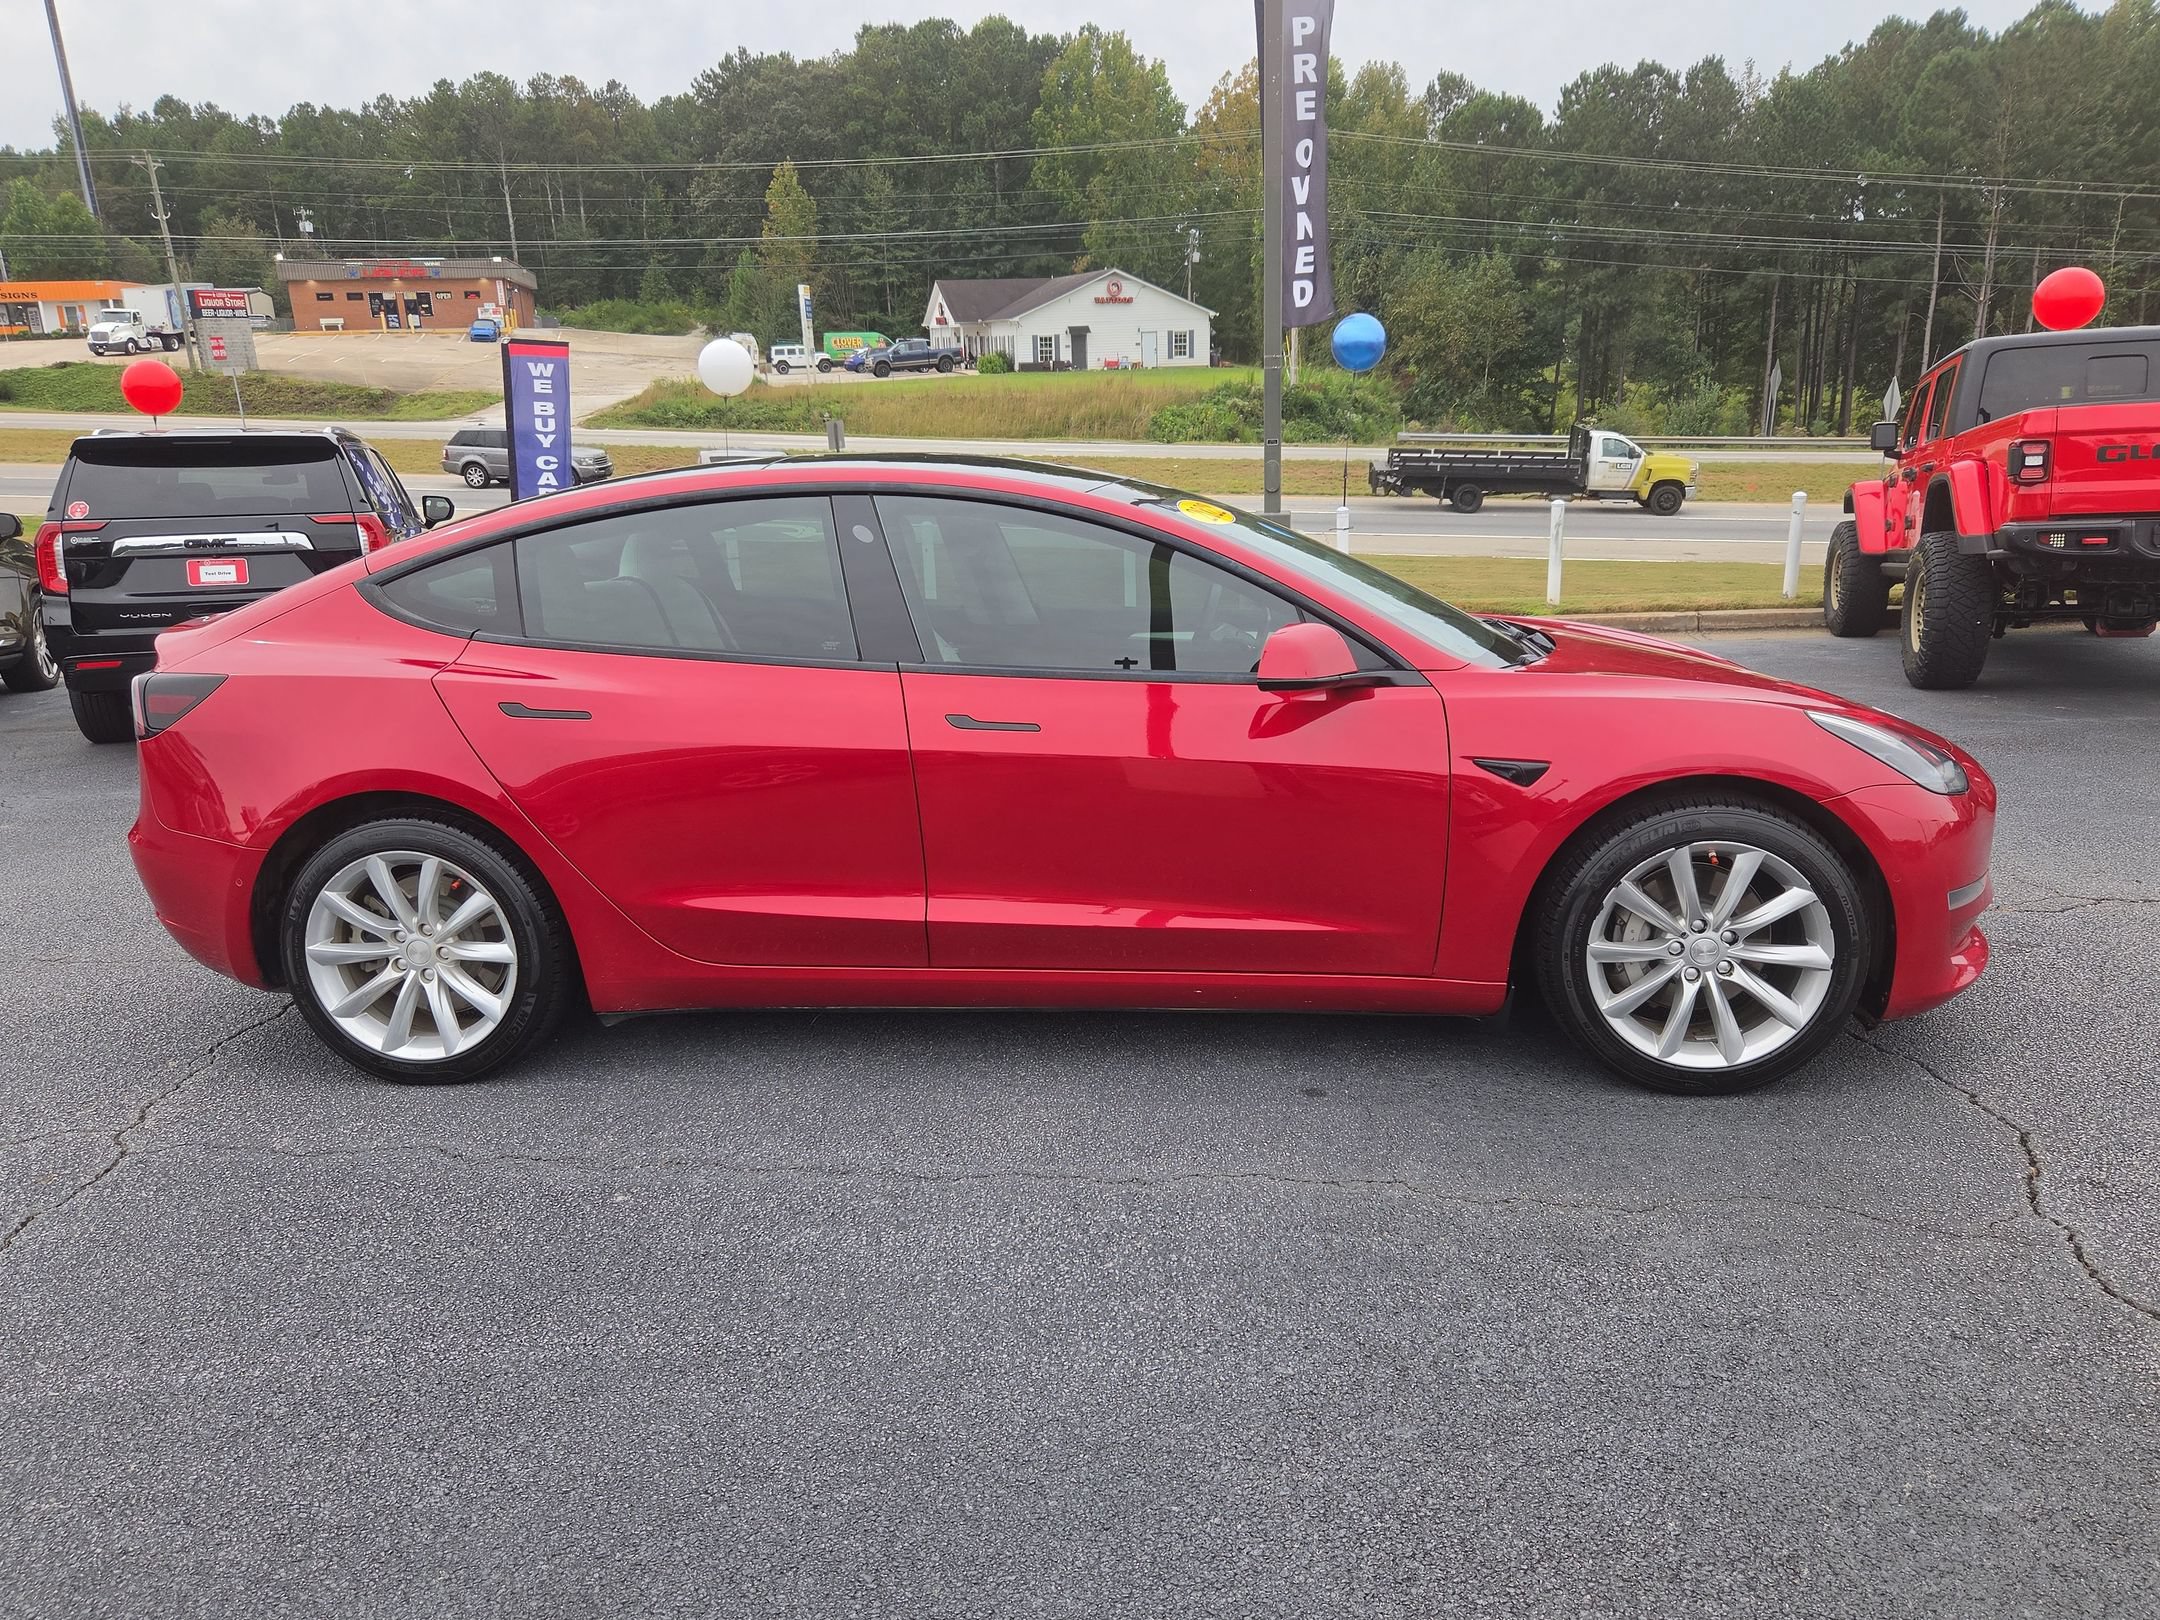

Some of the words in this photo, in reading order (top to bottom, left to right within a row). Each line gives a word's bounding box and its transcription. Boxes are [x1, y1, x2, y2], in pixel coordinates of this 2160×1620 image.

[1291, 16, 1317, 121] PRE
[436, 292, 452, 300] OPEN
[200, 297, 224, 307] LIQUOR
[225, 298, 246, 307] STORE
[831, 336, 862, 347] CLOVER
[527, 362, 554, 394] WE
[533, 401, 556, 448] BUY
[184, 538, 238, 548] GMC
